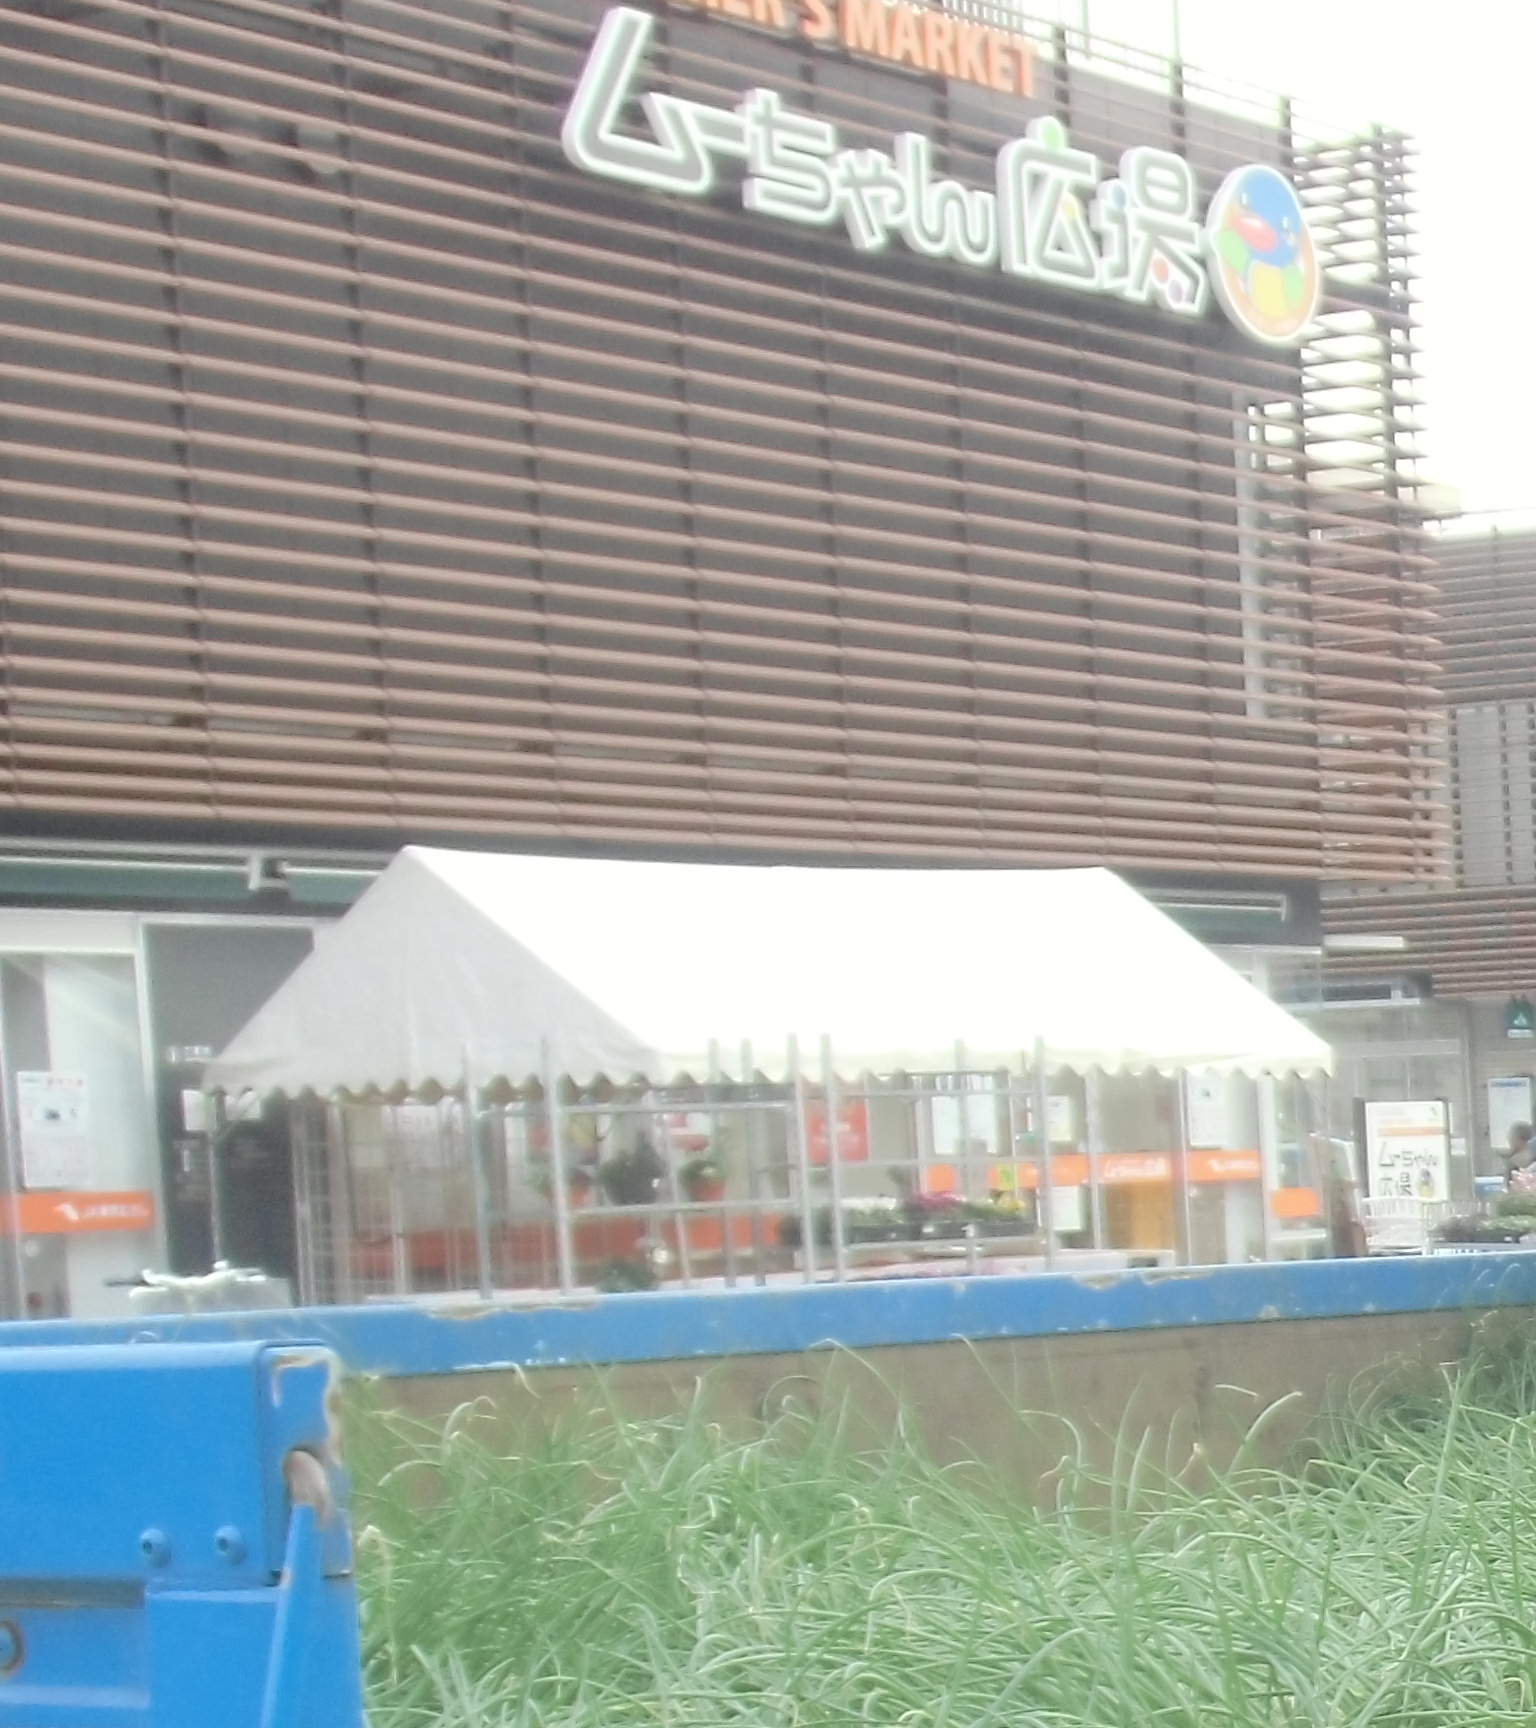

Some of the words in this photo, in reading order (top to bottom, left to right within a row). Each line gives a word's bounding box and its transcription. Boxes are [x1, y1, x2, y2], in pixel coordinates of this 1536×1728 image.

[838, 0, 1037, 98] MARKET
[562, 5, 1203, 315] ムーちゃん広場
